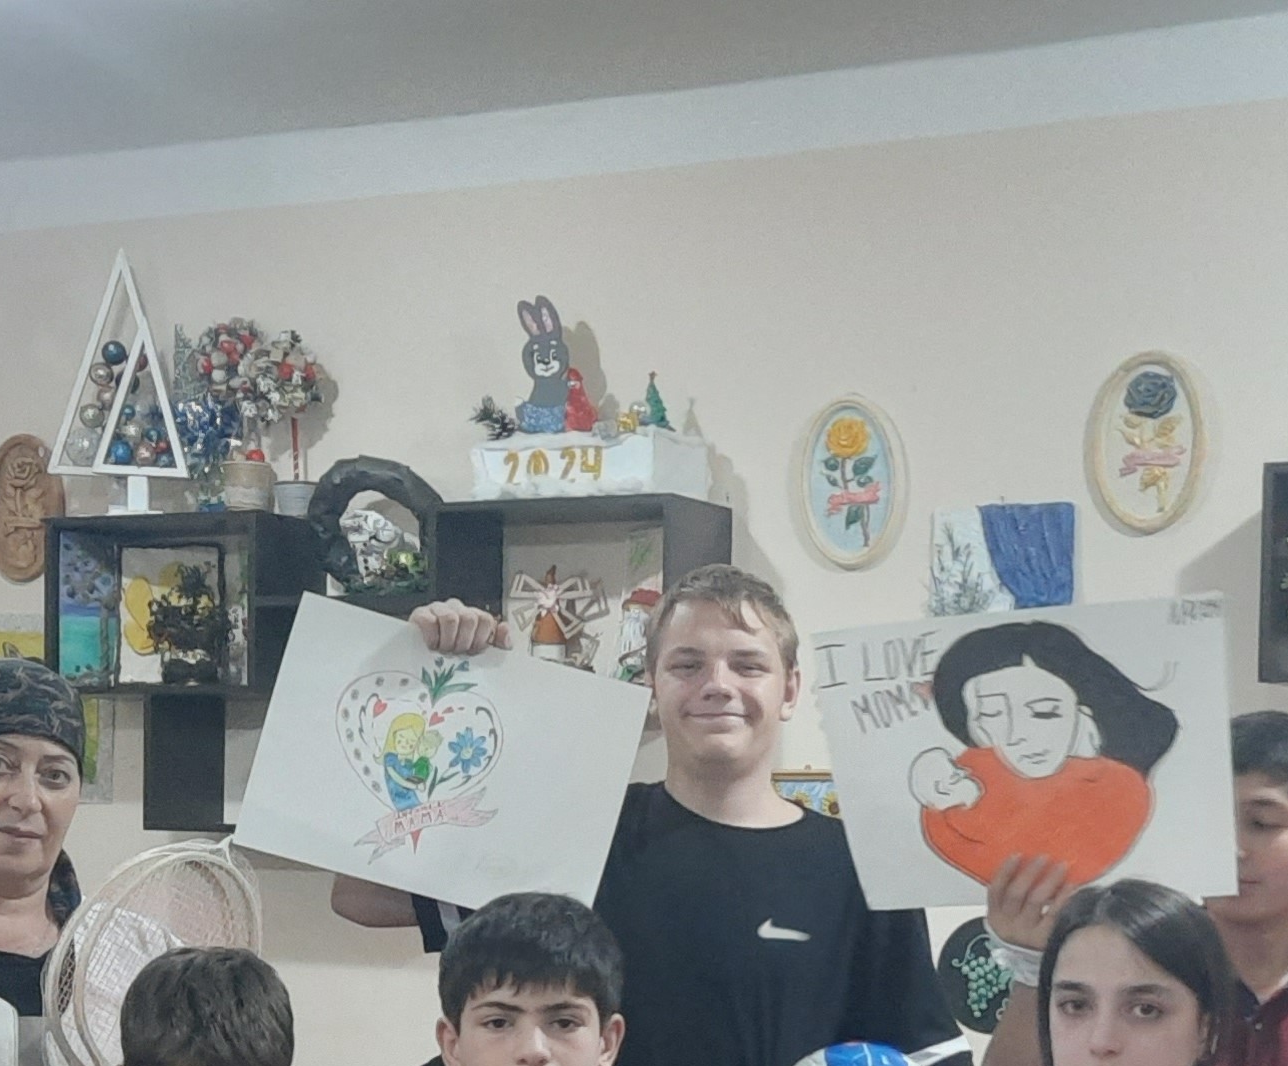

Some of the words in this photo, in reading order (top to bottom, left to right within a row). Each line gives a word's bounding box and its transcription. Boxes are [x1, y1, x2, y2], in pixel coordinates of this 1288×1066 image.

[503, 446, 602, 486] 2024
[814, 644, 848, 689] I
[861, 629, 940, 681] LOVE
